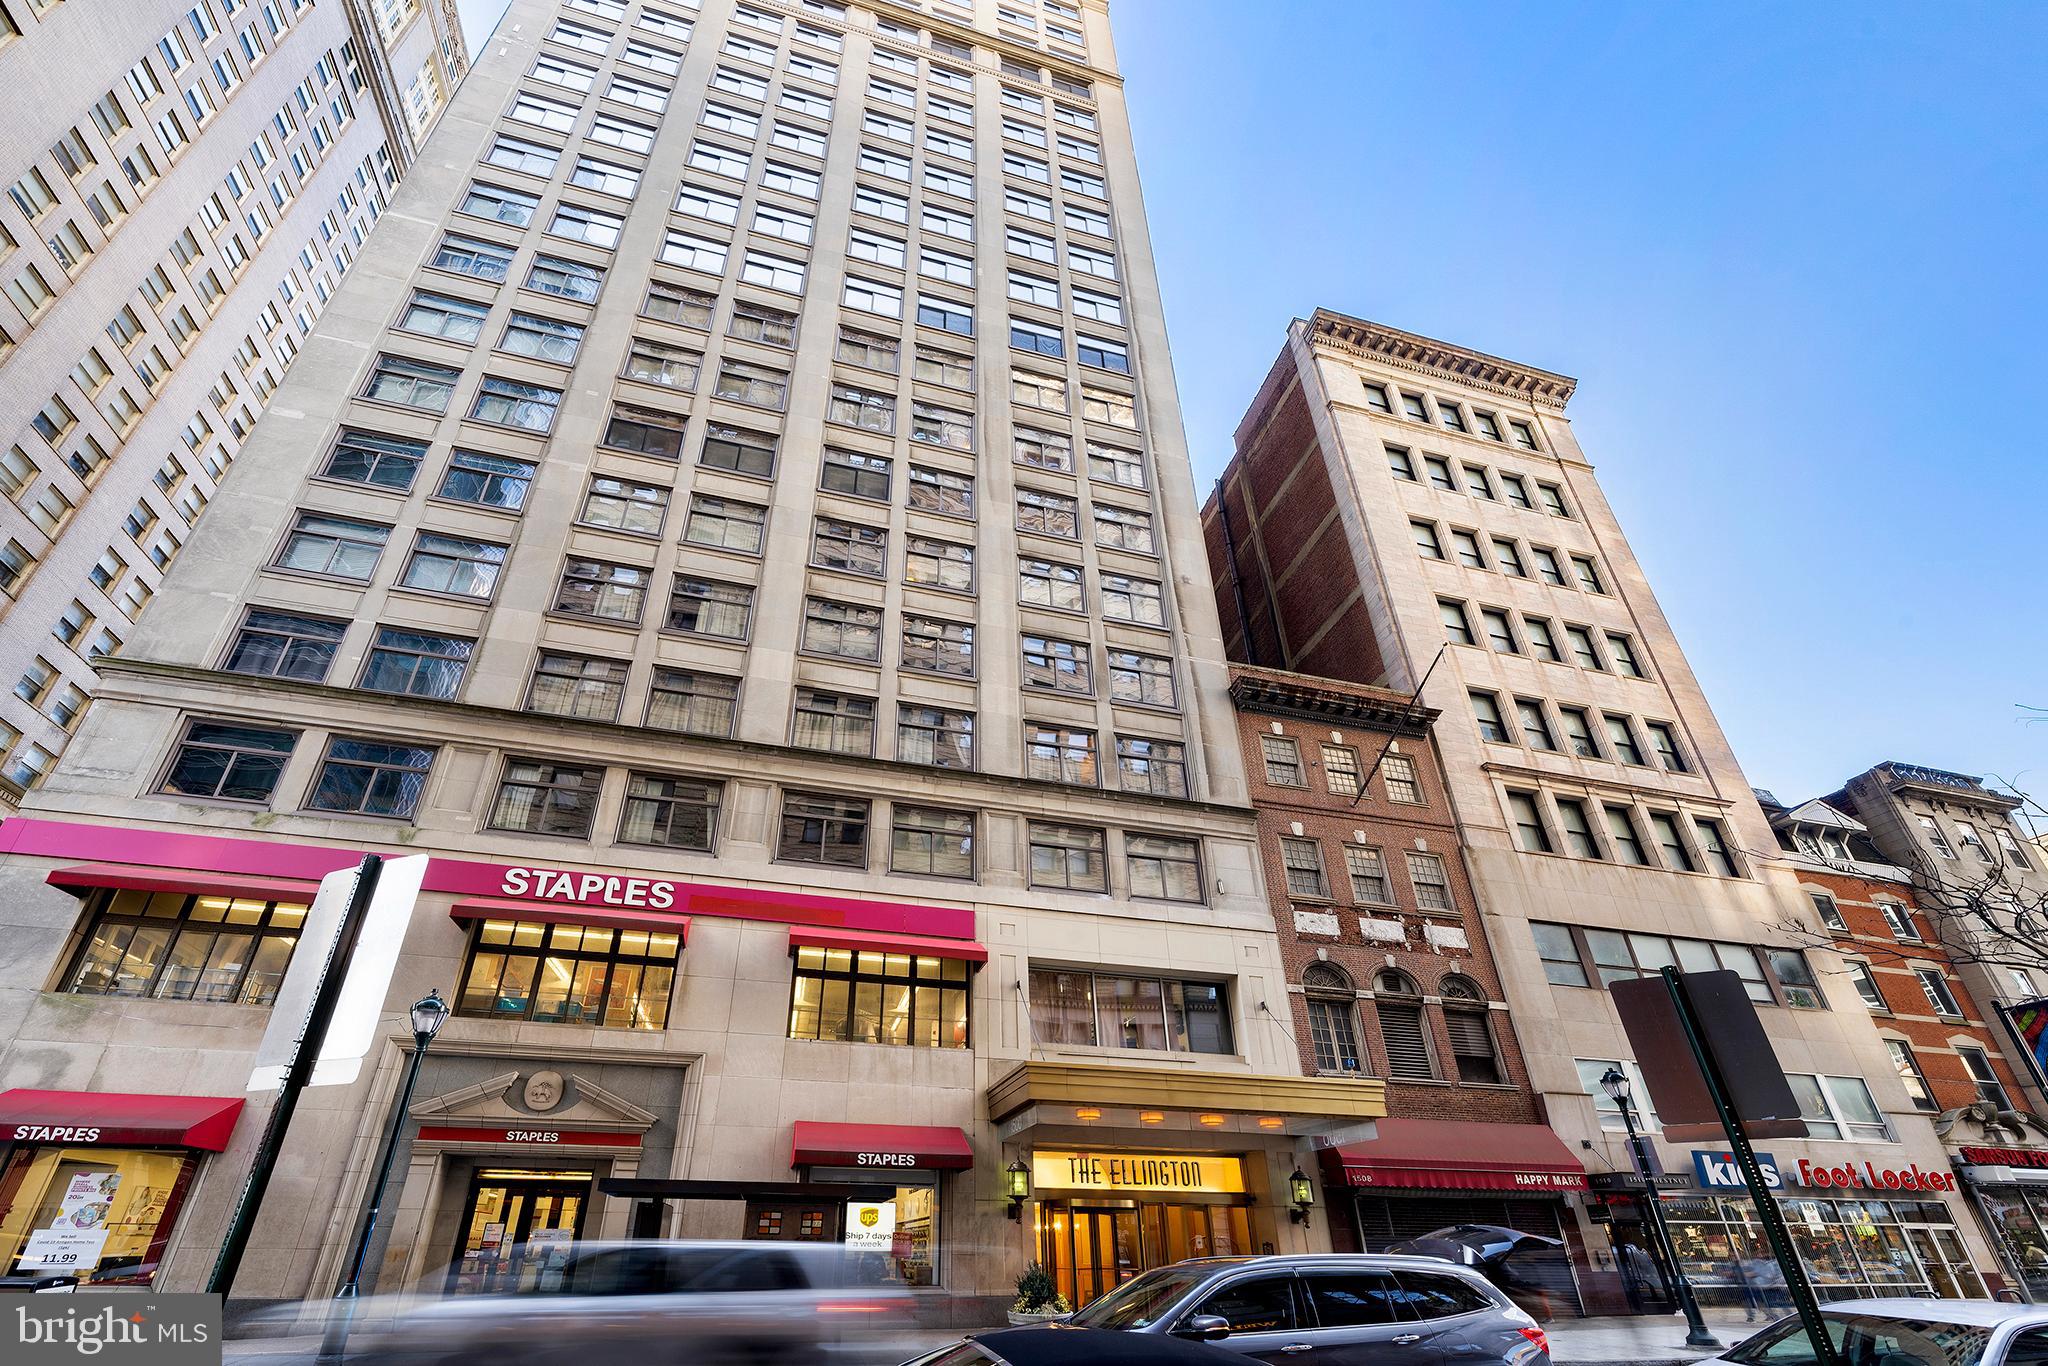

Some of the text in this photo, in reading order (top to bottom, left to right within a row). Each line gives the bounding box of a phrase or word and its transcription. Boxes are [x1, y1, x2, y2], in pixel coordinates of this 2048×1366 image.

[501, 868, 675, 908] STAPLES
[13, 1126, 100, 1142] STAPLES
[506, 1131, 559, 1142] STAPLES
[857, 1153, 915, 1166] STAPLES
[1068, 1158, 1202, 1187] THE ELLINGTON
[1352, 1174, 1373, 1183] 1508
[1794, 1158, 1955, 1192] Foot Locker
[1515, 1174, 1583, 1186] HAPPY MARK
[1652, 1177, 1688, 1185] HESTNUT
[861, 1213, 878, 1225] ups
[845, 1231, 864, 1241] Ship
[871, 1231, 892, 1241] days
[859, 1240, 882, 1248] week
[41, 1253, 78, 1263] 11.99
